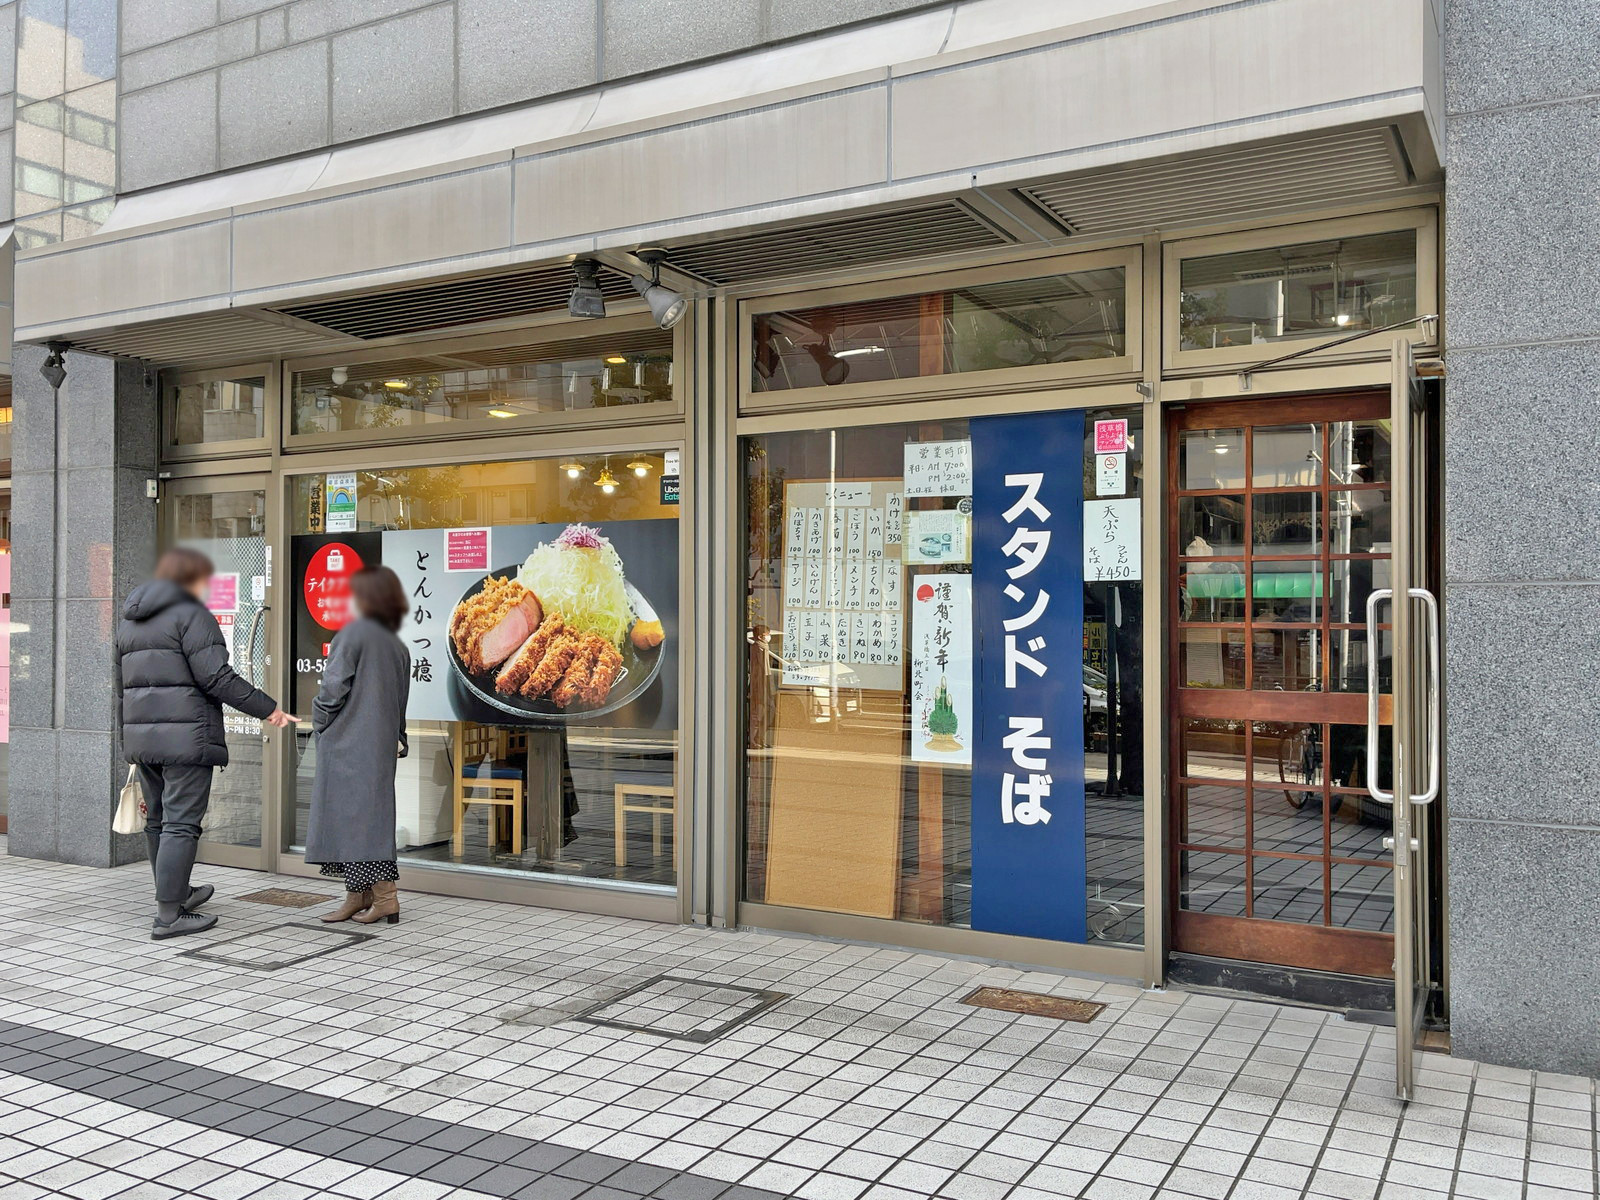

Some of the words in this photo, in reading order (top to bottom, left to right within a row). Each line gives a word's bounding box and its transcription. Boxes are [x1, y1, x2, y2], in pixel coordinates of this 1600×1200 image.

[1099, 424, 1123, 433] 浅草橋
[919, 446, 968, 459] 営業時間
[928, 462, 940, 471] AM
[945, 462, 964, 471] 7:00
[828, 488, 863, 500] メニュー
[309, 485, 322, 533] 営業中
[890, 497, 900, 518] かけ
[794, 511, 804, 541] かぼちゃ
[811, 513, 822, 544] かきあげ
[850, 513, 861, 541] ごぼう
[870, 515, 881, 536] いか
[1102, 505, 1119, 543] 天ぷら
[887, 533, 902, 543] 350
[868, 550, 882, 558] 150
[1089, 546, 1101, 564] そば
[1117, 545, 1128, 564] うどん
[791, 563, 802, 587] アジ
[810, 563, 820, 595] いんげん
[850, 566, 859, 597] メンチ
[869, 566, 880, 595] ちくわ
[888, 566, 898, 592] なす
[1001, 472, 1051, 689] スタンド
[820, 619, 830, 648] 山菜
[838, 619, 847, 647] たぬき
[856, 619, 867, 647] きつね
[872, 619, 882, 648] わかめ
[890, 619, 898, 650] コロッケ
[934, 582, 954, 673] 謹賀新年
[802, 649, 814, 658] 50
[853, 650, 865, 660] 80
[870, 653, 882, 661] 80
[887, 653, 899, 661] 80
[913, 659, 924, 701] 柳北町会
[245, 716, 260, 725] 3:00
[245, 726, 260, 735] 8:30
[1001, 716, 1053, 826] そば
